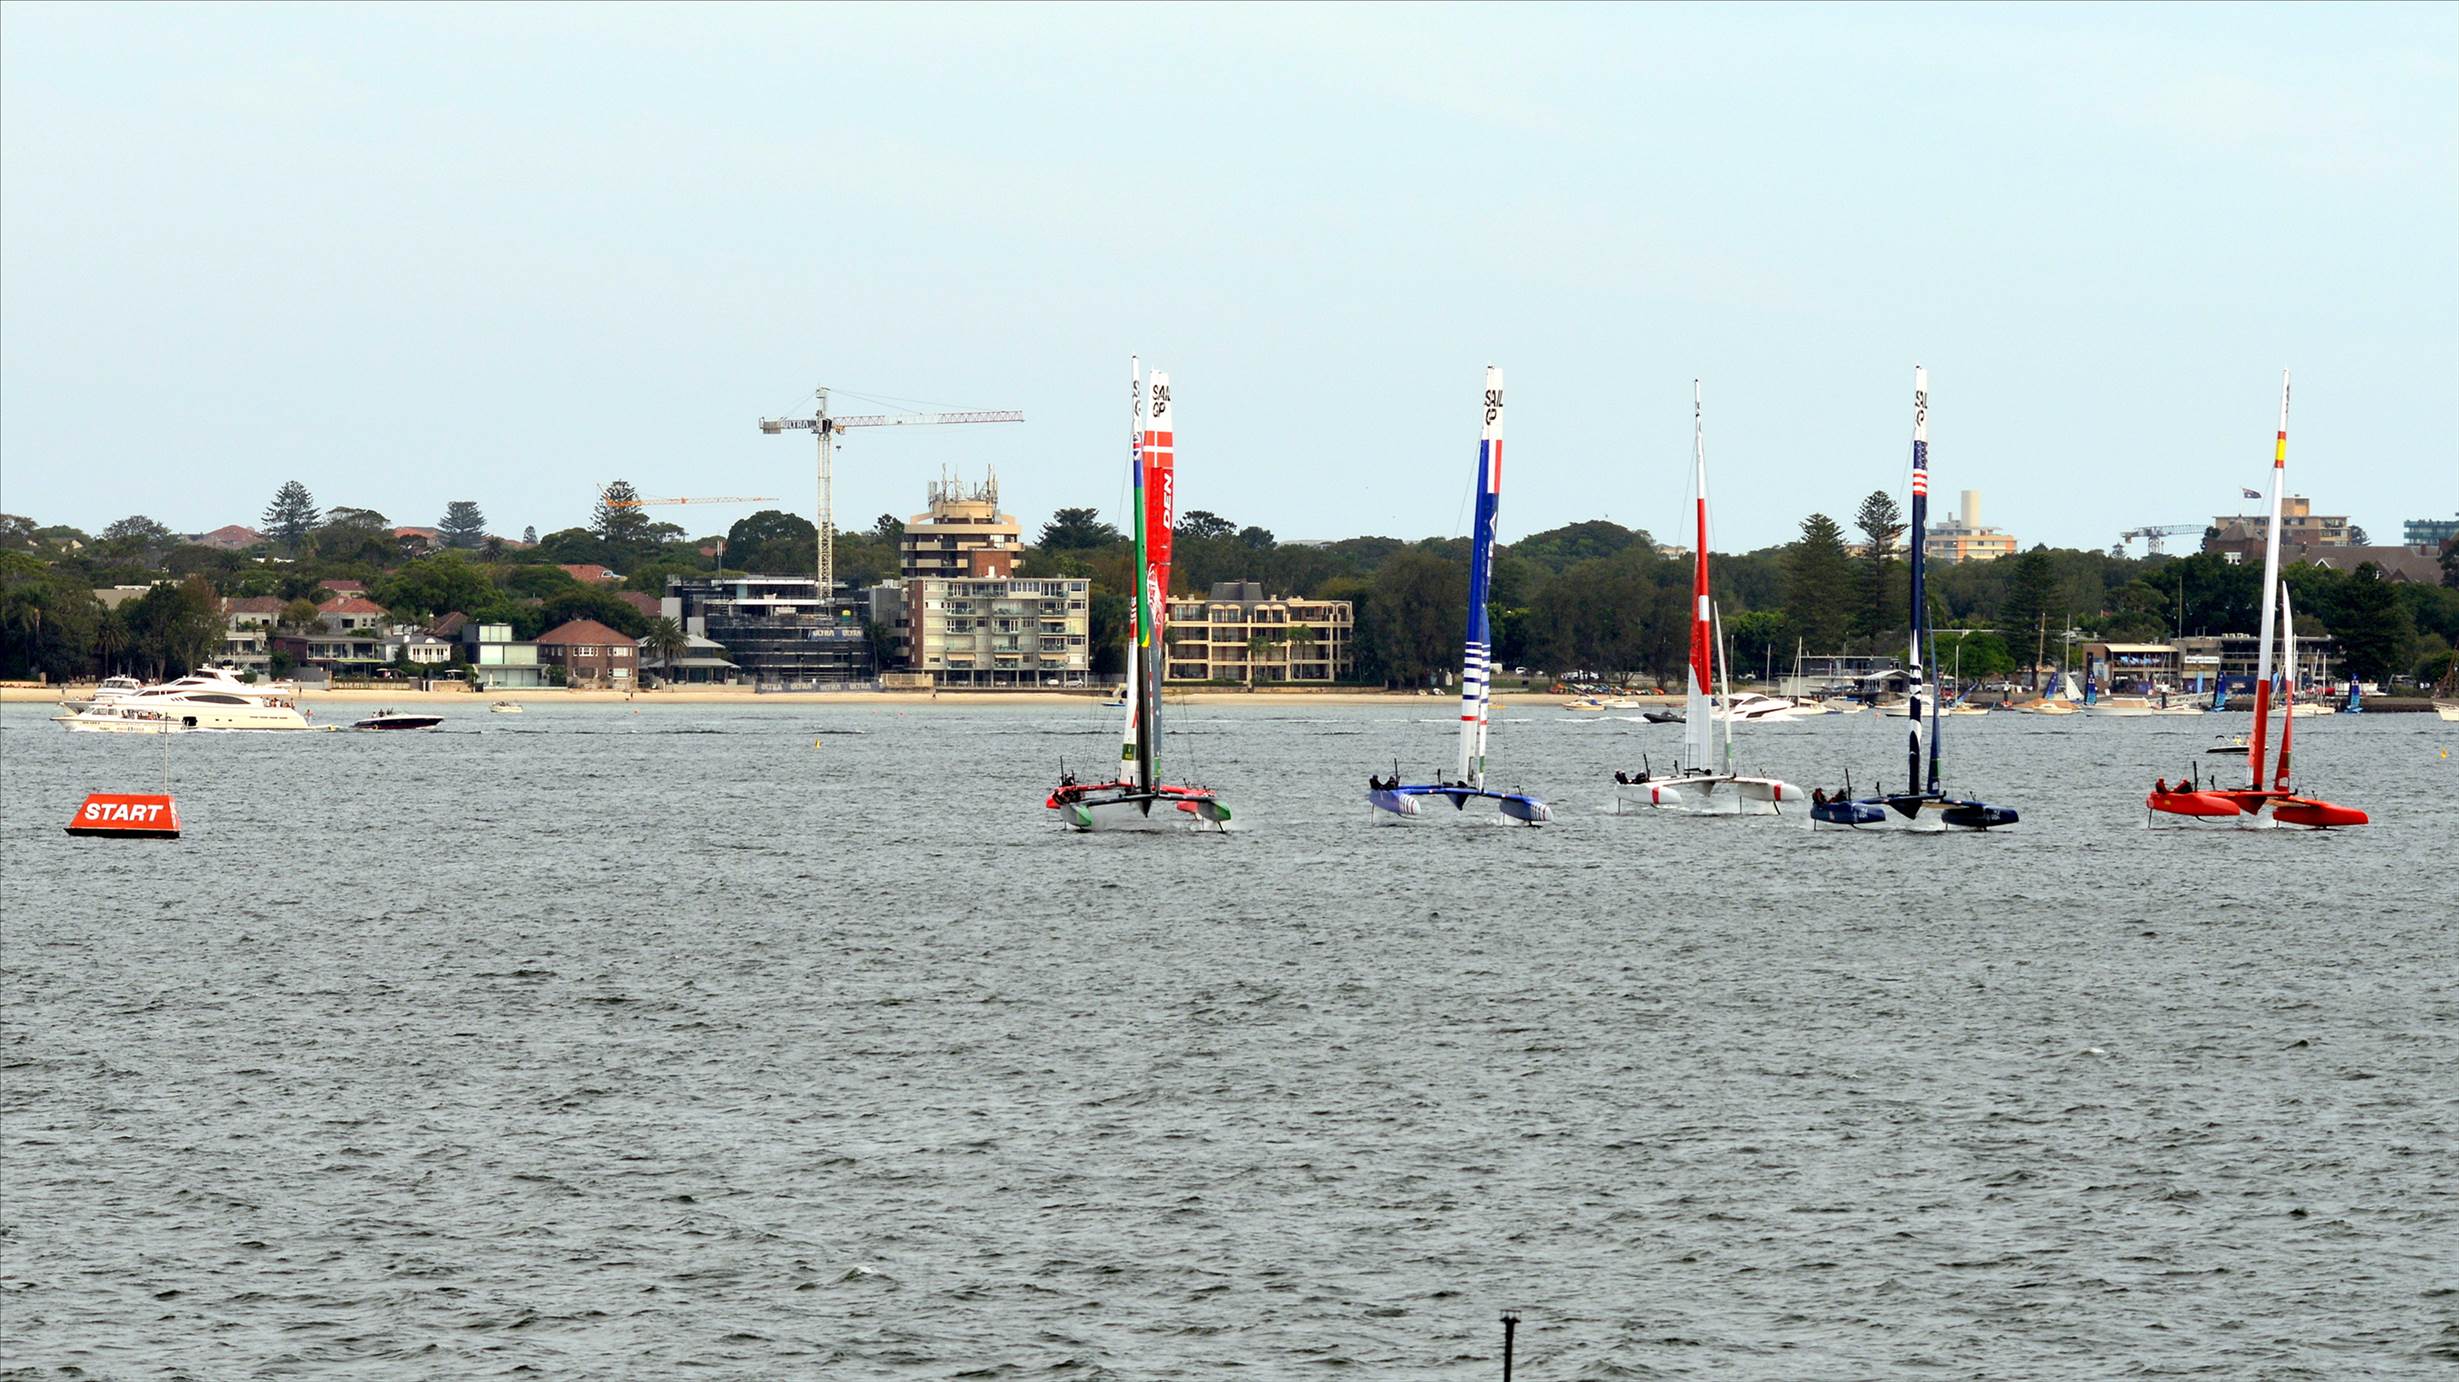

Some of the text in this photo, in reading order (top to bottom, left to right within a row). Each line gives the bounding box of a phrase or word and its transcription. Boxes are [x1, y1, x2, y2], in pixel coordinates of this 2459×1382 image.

[1915, 390, 1928, 409] SAL
[1153, 401, 1166, 418] GP
[85, 803, 164, 822] START
